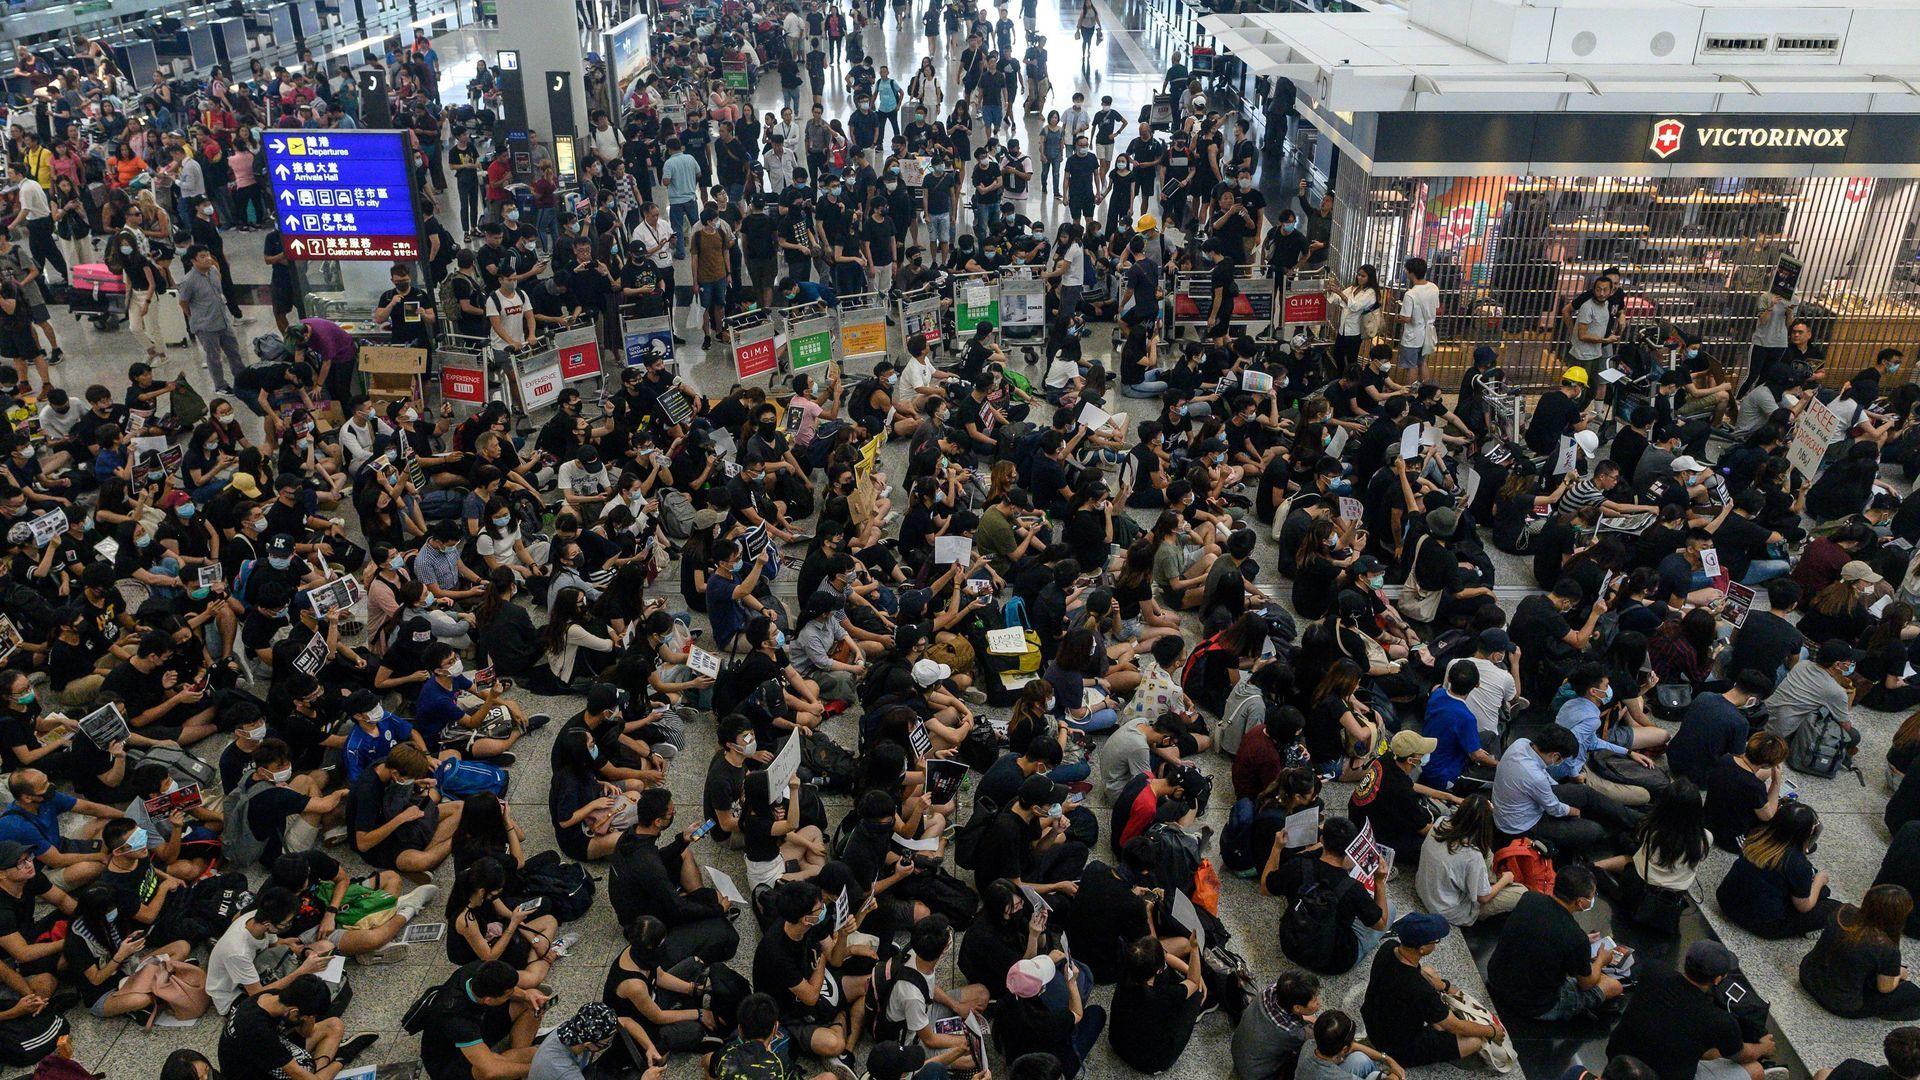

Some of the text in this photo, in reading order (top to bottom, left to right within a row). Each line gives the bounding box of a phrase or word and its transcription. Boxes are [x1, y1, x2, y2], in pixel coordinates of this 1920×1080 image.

[306, 136, 330, 147] 離港
[1697, 128, 1849, 147] VICTORINOX
[308, 148, 348, 156] Departures
[292, 162, 338, 173] 接機大堂
[295, 173, 338, 181] Arrivals Hall
[354, 187, 388, 198] 往市區
[366, 199, 380, 207] city
[321, 212, 354, 223] 停車場
[322, 223, 336, 231] Car
[326, 237, 372, 248] 旅客服務
[327, 248, 392, 256] Customer Service
[1290, 297, 1321, 307] QIMA
[741, 344, 769, 360] QIMA
[445, 373, 481, 385] EXPERIENCE
[524, 371, 558, 389] EXPERIENCE
[1807, 401, 1837, 433] FREE
